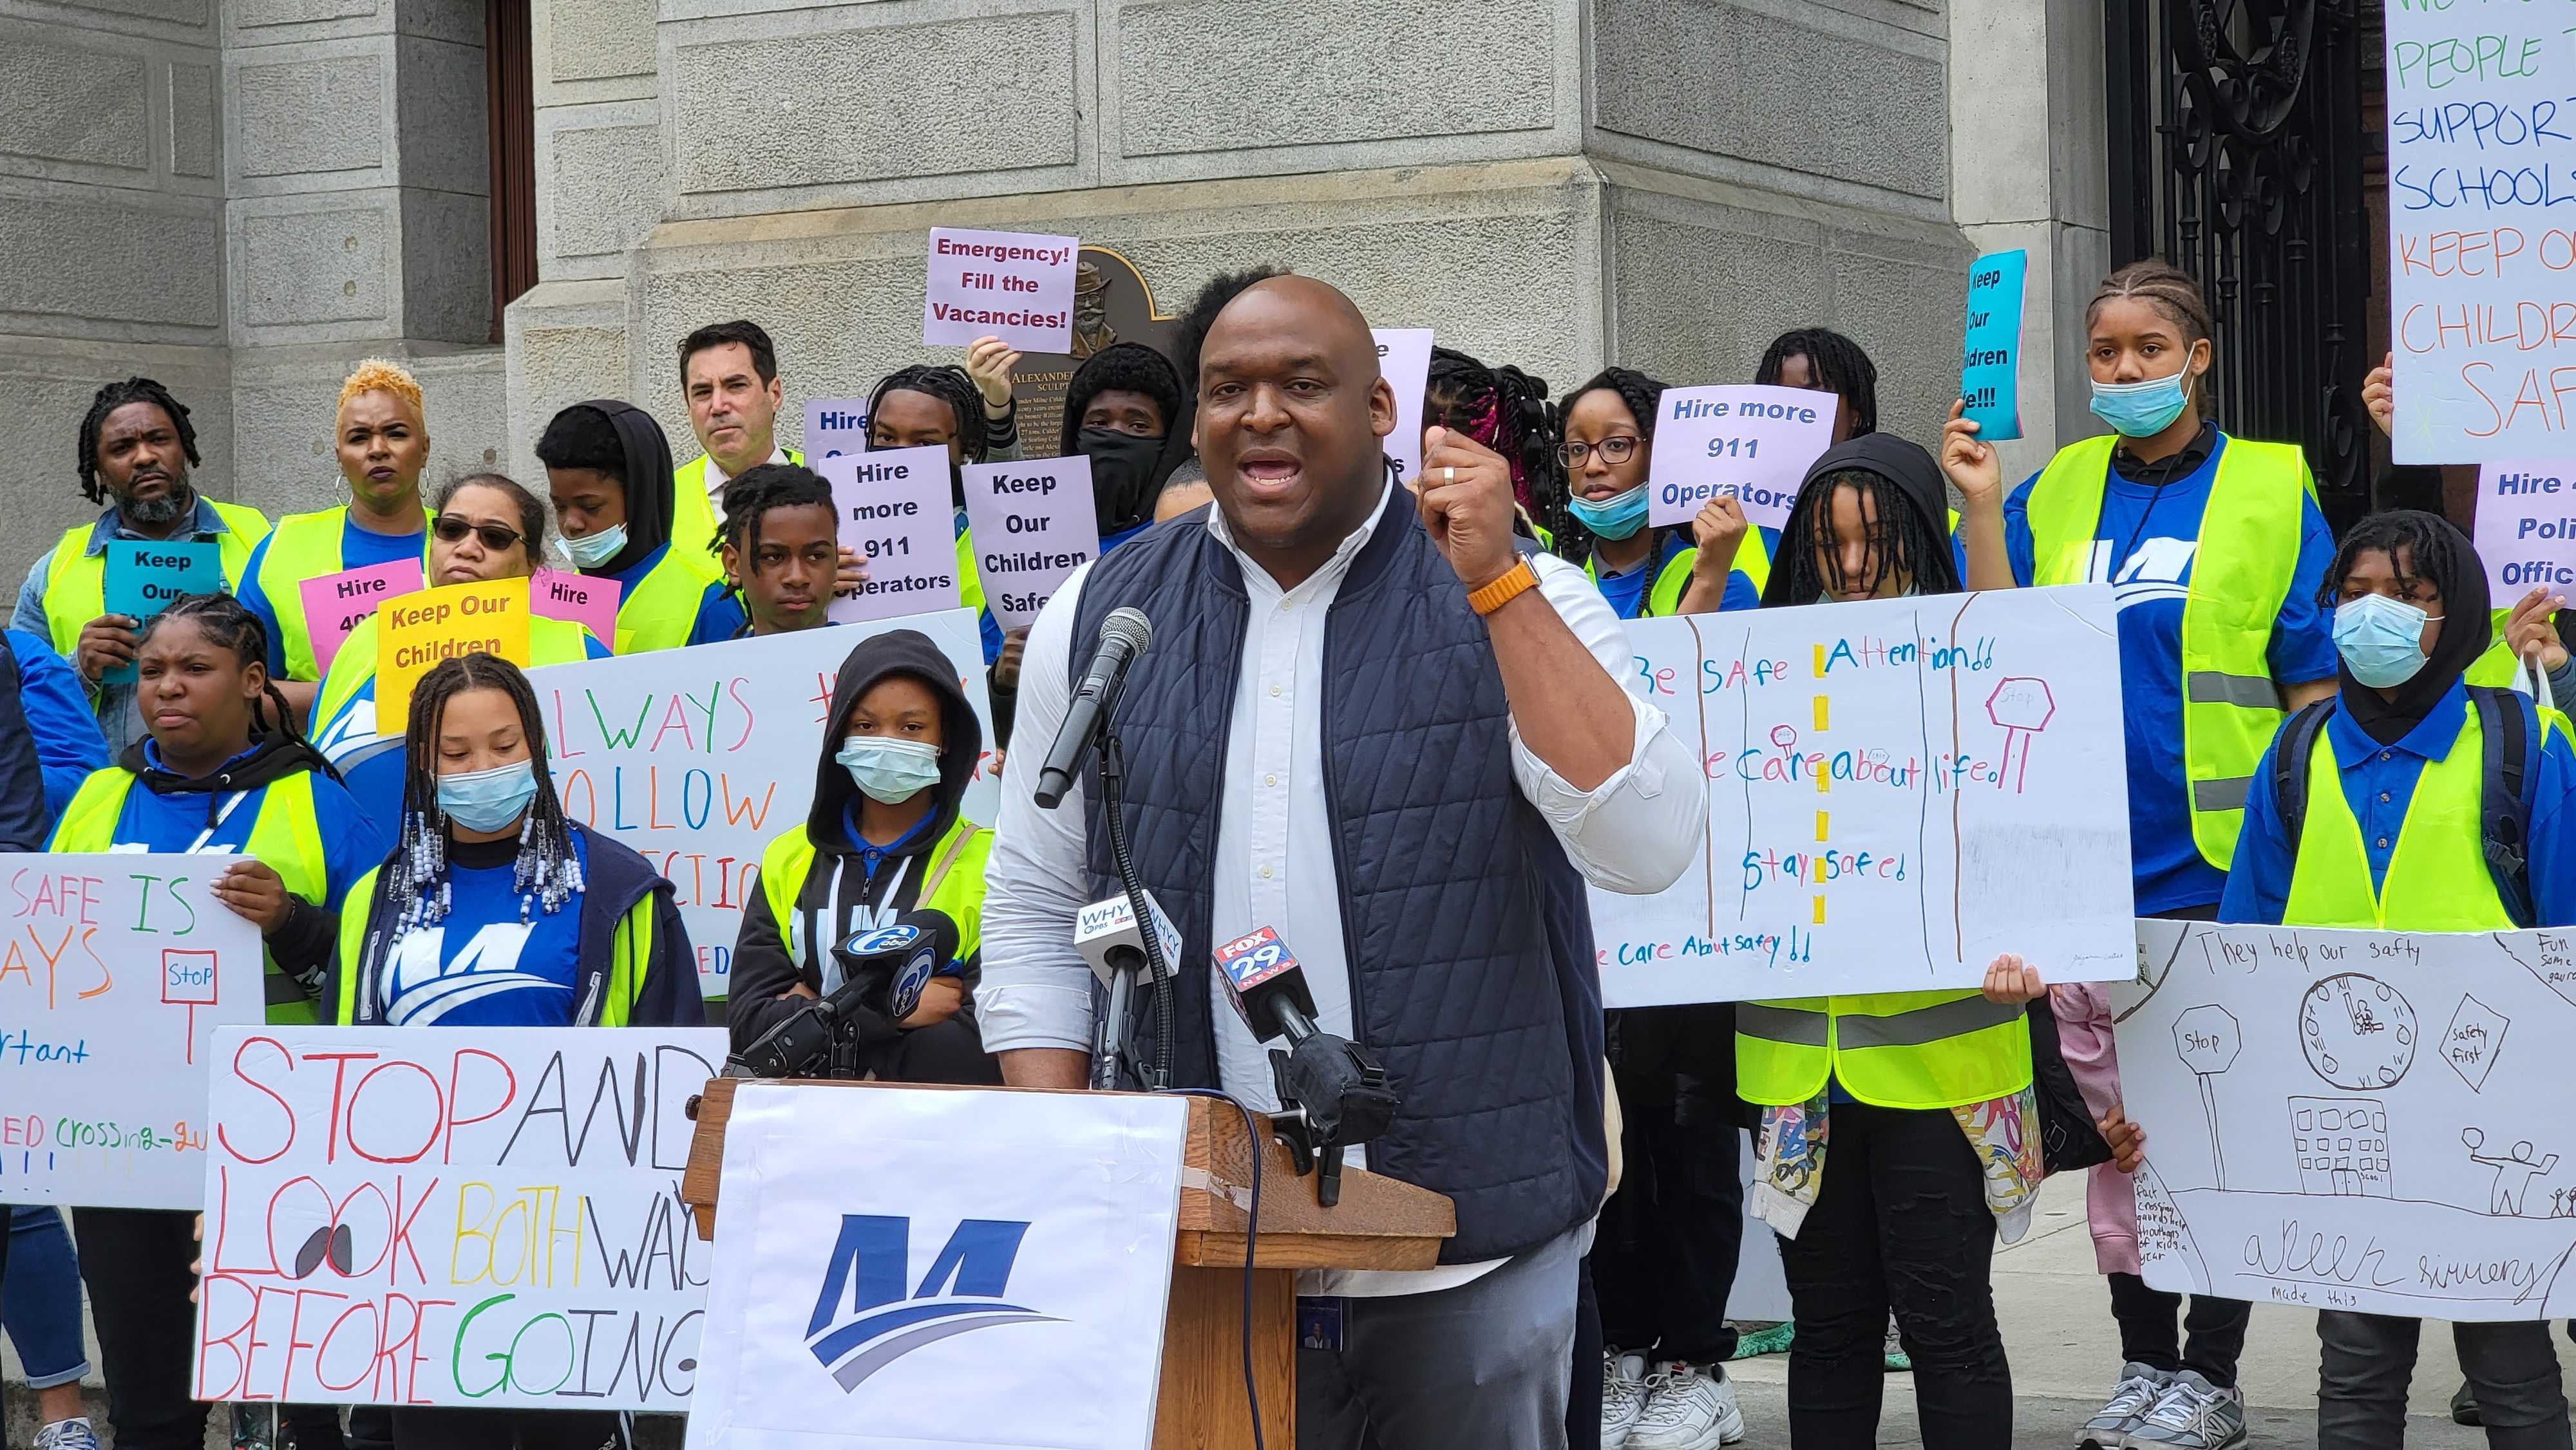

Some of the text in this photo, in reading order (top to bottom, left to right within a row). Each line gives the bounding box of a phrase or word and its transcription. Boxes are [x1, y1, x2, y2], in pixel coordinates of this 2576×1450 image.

[2394, 34, 2543, 89] PEOPLE
[2394, 163, 2576, 211] SCHOOL
[937, 238, 1069, 266] Emergency!
[2400, 227, 2524, 278] KEEP
[961, 272, 1039, 293] Fill the
[1971, 268, 2001, 290] Keep
[933, 303, 1066, 329] Vacancies!
[1969, 310, 1990, 330] Our
[820, 411, 869, 430] Hire
[1673, 399, 1817, 424] Hire more
[1707, 438, 1758, 458] 911
[857, 463, 909, 484] Hire
[992, 475, 1057, 495] Keep
[2498, 473, 2561, 495] Hire
[1663, 482, 1797, 511] Operators
[853, 501, 918, 521] more
[1006, 514, 1050, 533] Our
[865, 536, 909, 558] 911
[135, 551, 191, 572] Keep
[985, 551, 1086, 573] Children
[2502, 561, 2576, 585] Offic
[142, 584, 184, 599] Our
[337, 578, 386, 599] Hire
[550, 581, 588, 605] Hire
[392, 596, 511, 630] Keep Our
[1001, 590, 1056, 612] Safe
[395, 637, 502, 668] Children
[546, 676, 755, 760] LWAYS
[550, 766, 776, 831] OLLOW
[12, 867, 195, 936] SAFE IS
[1083, 902, 1128, 926] WHY
[881, 937, 909, 946] abc
[1222, 931, 1269, 958] FOX
[2195, 931, 2258, 975] They
[2269, 932, 2310, 974] help
[2320, 943, 2347, 961] our
[2537, 933, 2569, 953] Fun
[1231, 945, 1281, 981] 29
[1243, 961, 1291, 986] NEWS
[218, 1036, 716, 1170] STOP AND
[214, 1165, 440, 1286] LOOK
[450, 1182, 585, 1288] BOTH
[2327, 1288, 2358, 1307] this
[196, 1274, 705, 1404] BEFORE GOING
